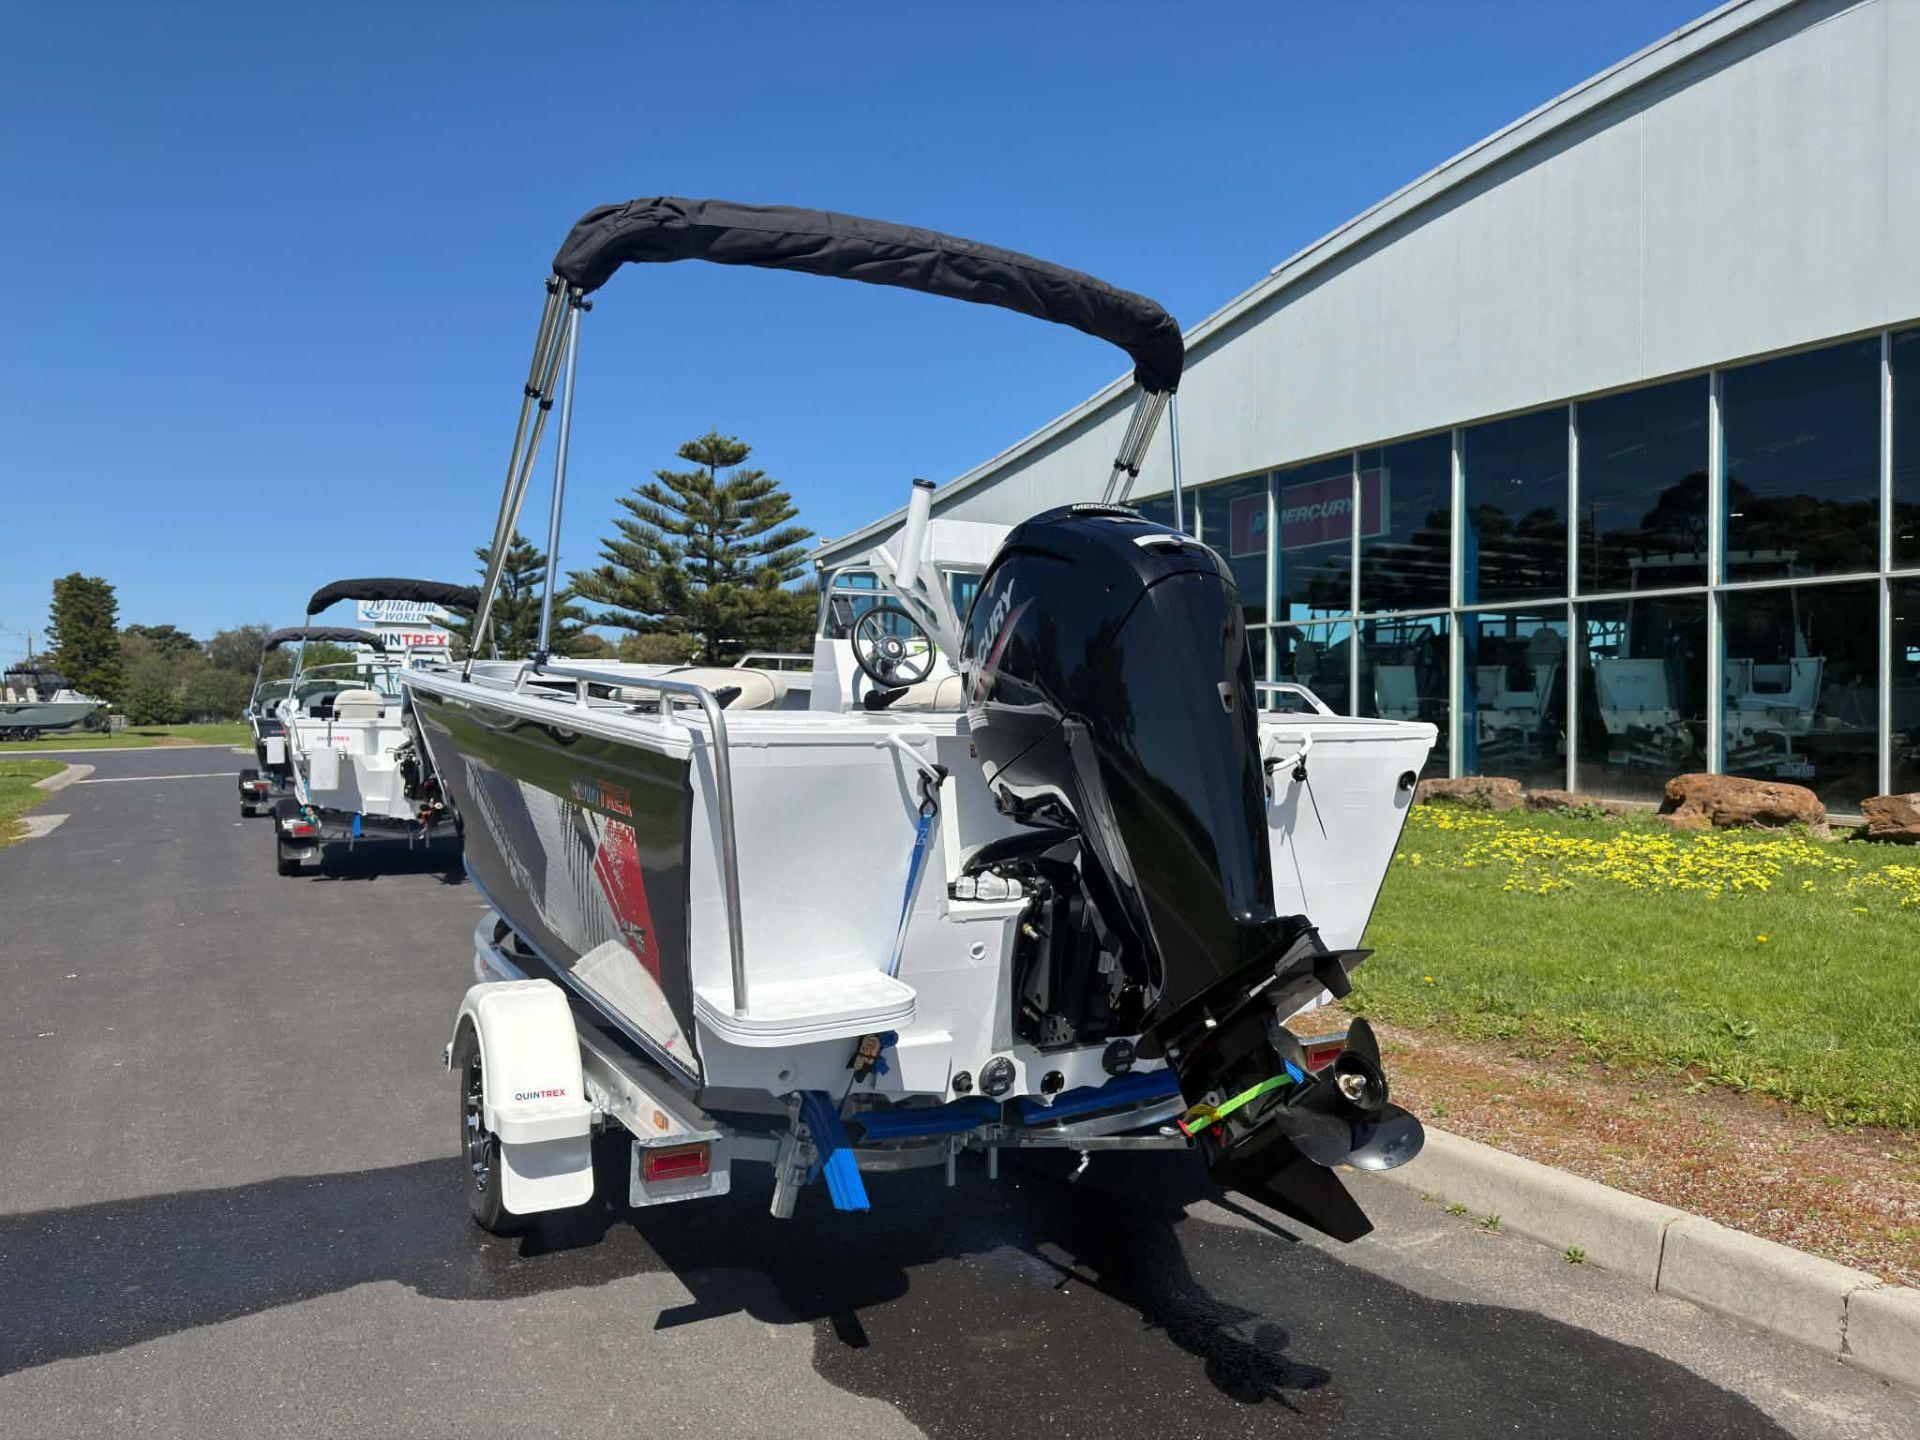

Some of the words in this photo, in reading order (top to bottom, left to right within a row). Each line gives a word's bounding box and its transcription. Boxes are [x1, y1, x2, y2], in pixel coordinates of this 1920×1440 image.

[385, 612, 425, 621] WORLD
[977, 578, 1015, 670] CURY
[380, 633, 446, 647] INTREX
[515, 1089, 566, 1101] QUINTREX
